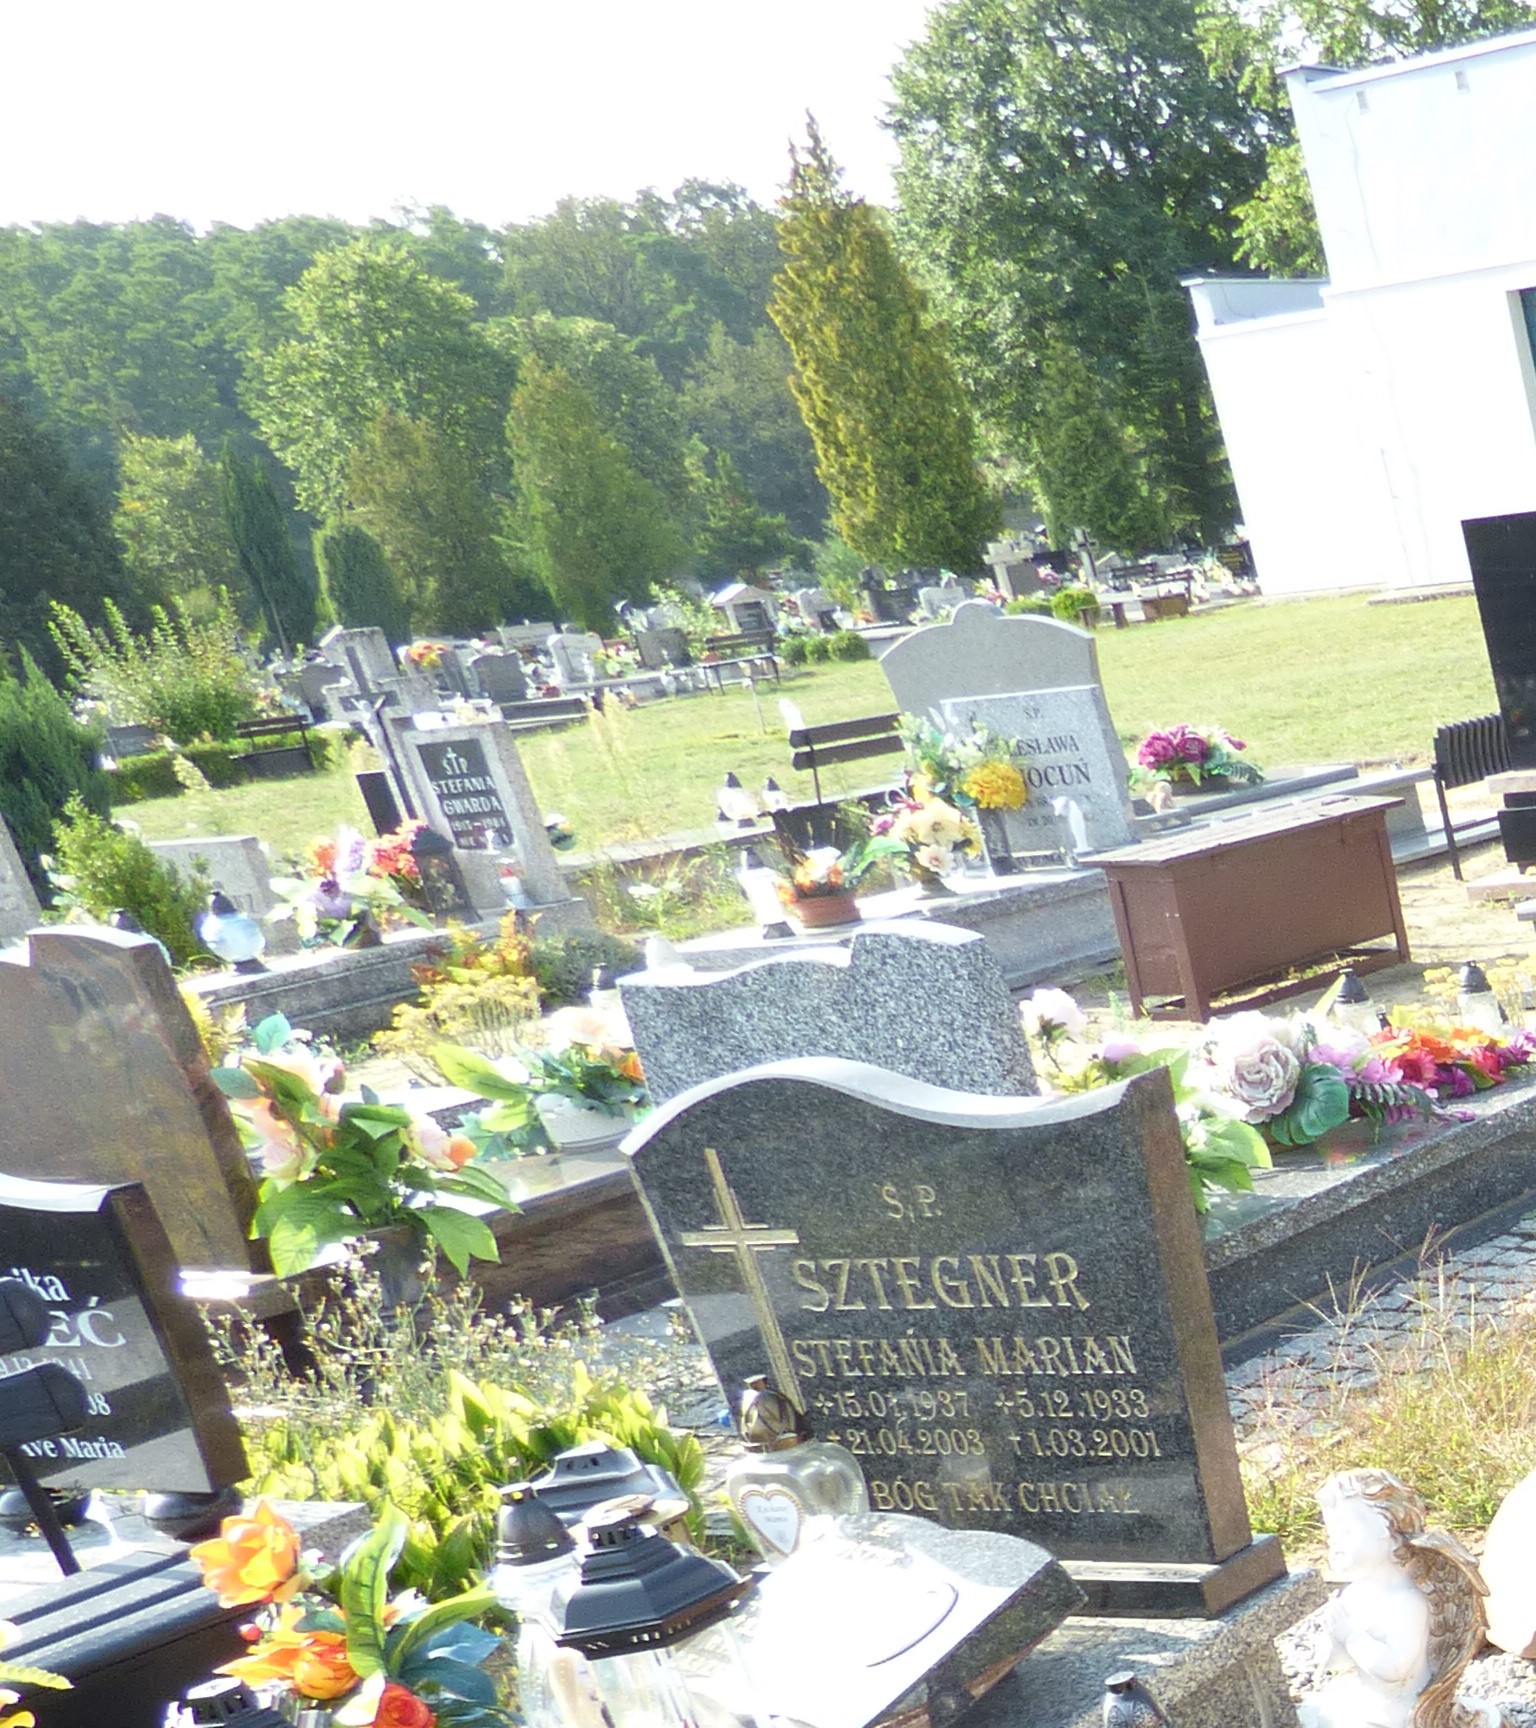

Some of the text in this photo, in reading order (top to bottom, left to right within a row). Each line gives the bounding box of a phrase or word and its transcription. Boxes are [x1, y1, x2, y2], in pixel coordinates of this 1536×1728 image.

[1020, 757, 1091, 789] OCUŃ
[792, 1252, 1090, 1312] SZTEGNER
[792, 1336, 1137, 1377] STEFANIA MARIAN
[59, 1437, 127, 1459] Maria
[870, 1475, 939, 1511] BÓG
